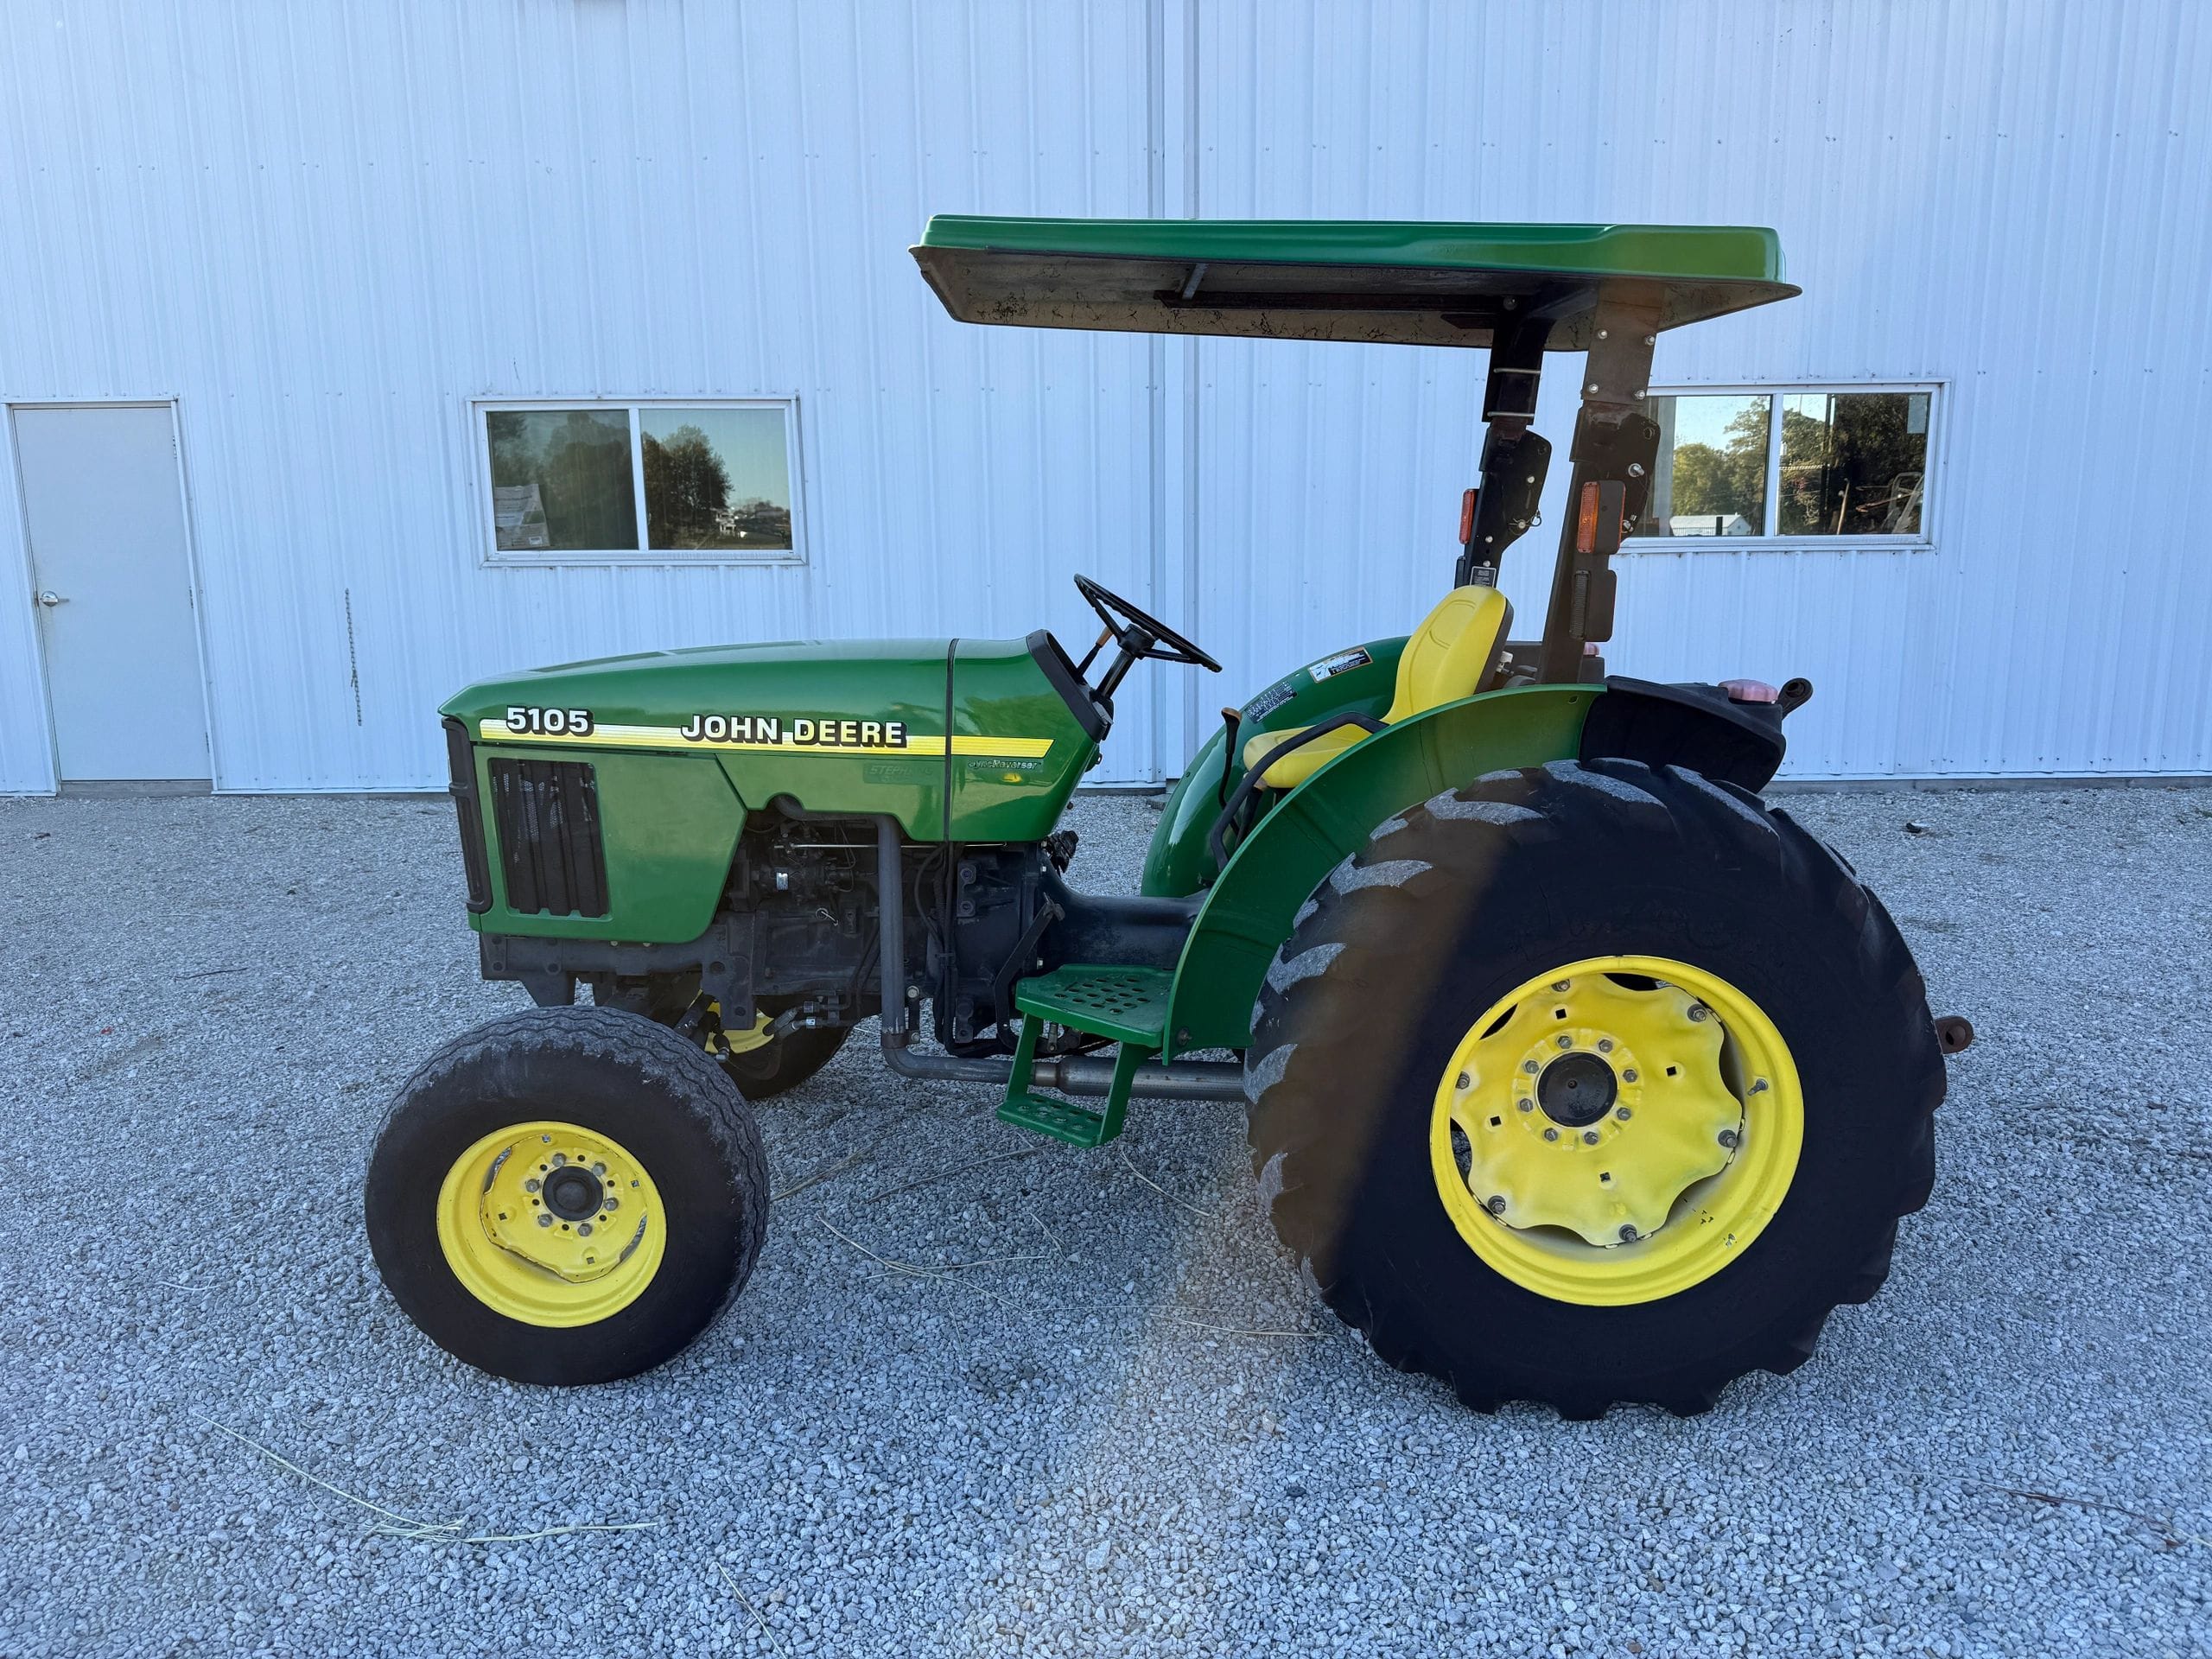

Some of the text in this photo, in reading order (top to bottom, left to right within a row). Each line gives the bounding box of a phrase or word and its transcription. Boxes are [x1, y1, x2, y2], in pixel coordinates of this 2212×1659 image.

[506, 705, 594, 736] 5105
[681, 715, 906, 748] JOHN DEERE
